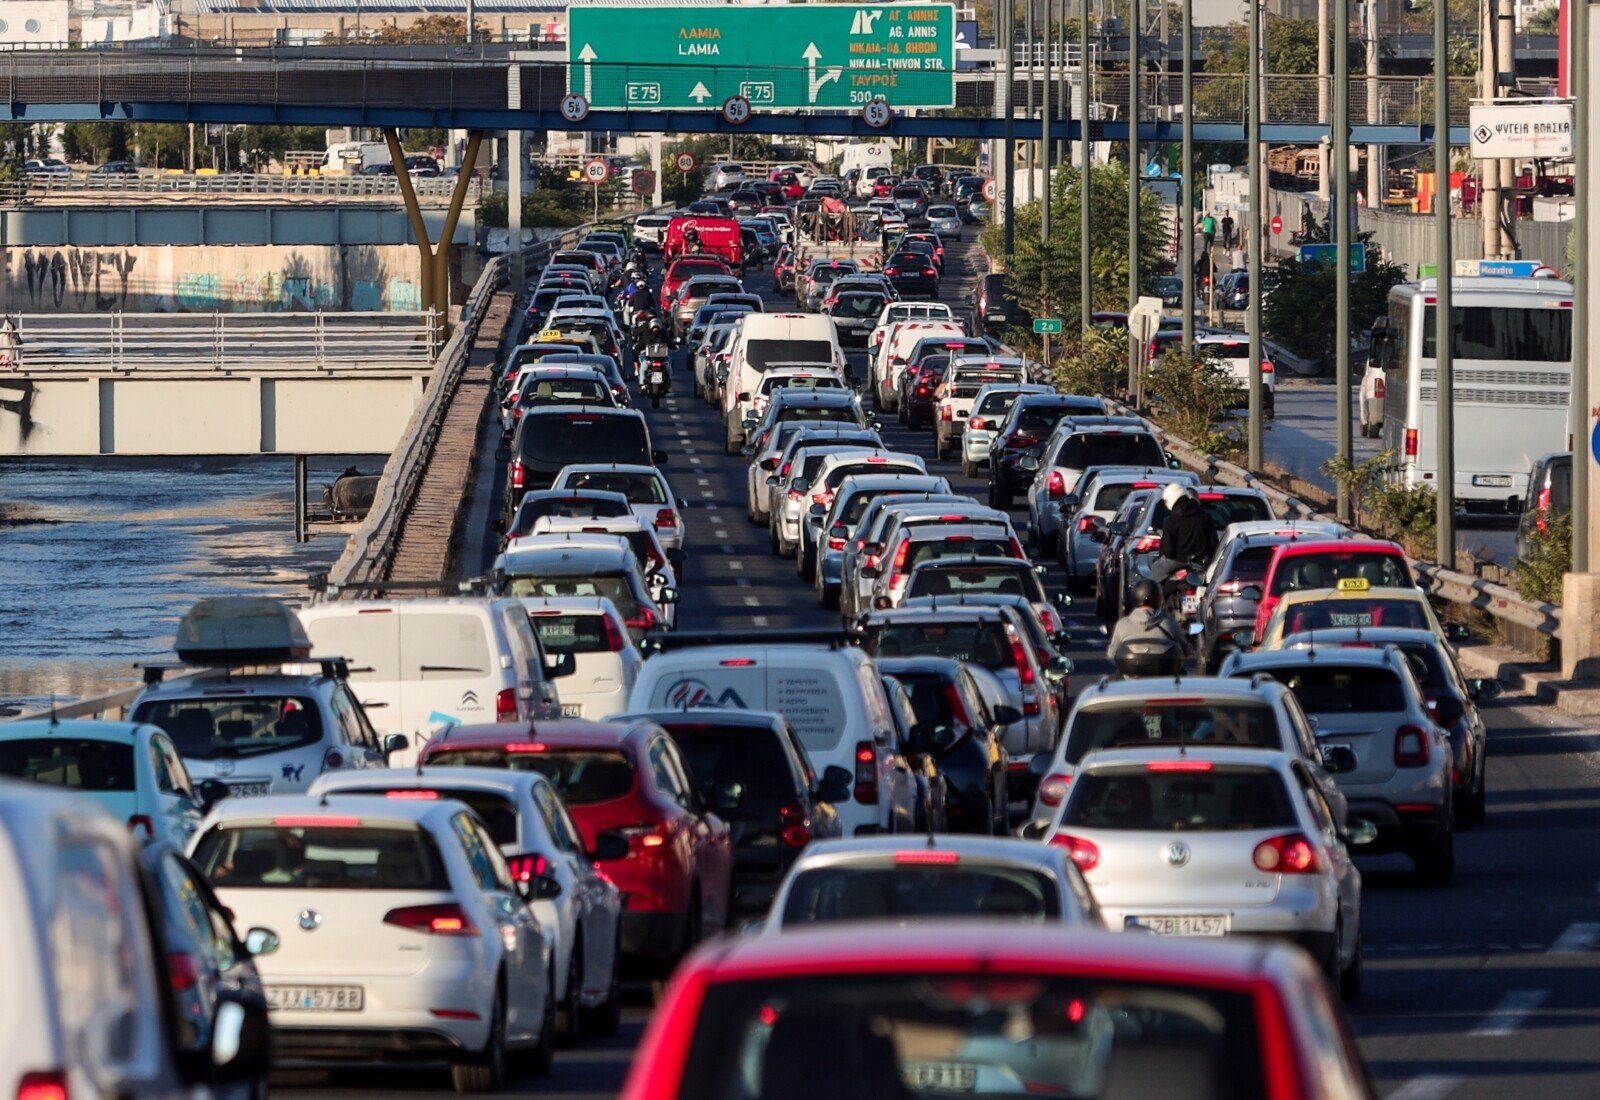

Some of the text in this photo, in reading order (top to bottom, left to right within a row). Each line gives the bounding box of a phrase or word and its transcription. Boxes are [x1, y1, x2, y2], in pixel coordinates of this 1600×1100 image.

[679, 28, 721, 39] ΛΑΜΙΑ
[889, 26, 937, 38] AG. ANNIS
[678, 43, 720, 55] LAMIA
[924, 58, 945, 70] STR.
[629, 86, 657, 100] E 75
[755, 86, 771, 99] 75
[850, 90, 872, 103] 500
[680, 158, 692, 167] 80
[590, 166, 604, 176] 80
